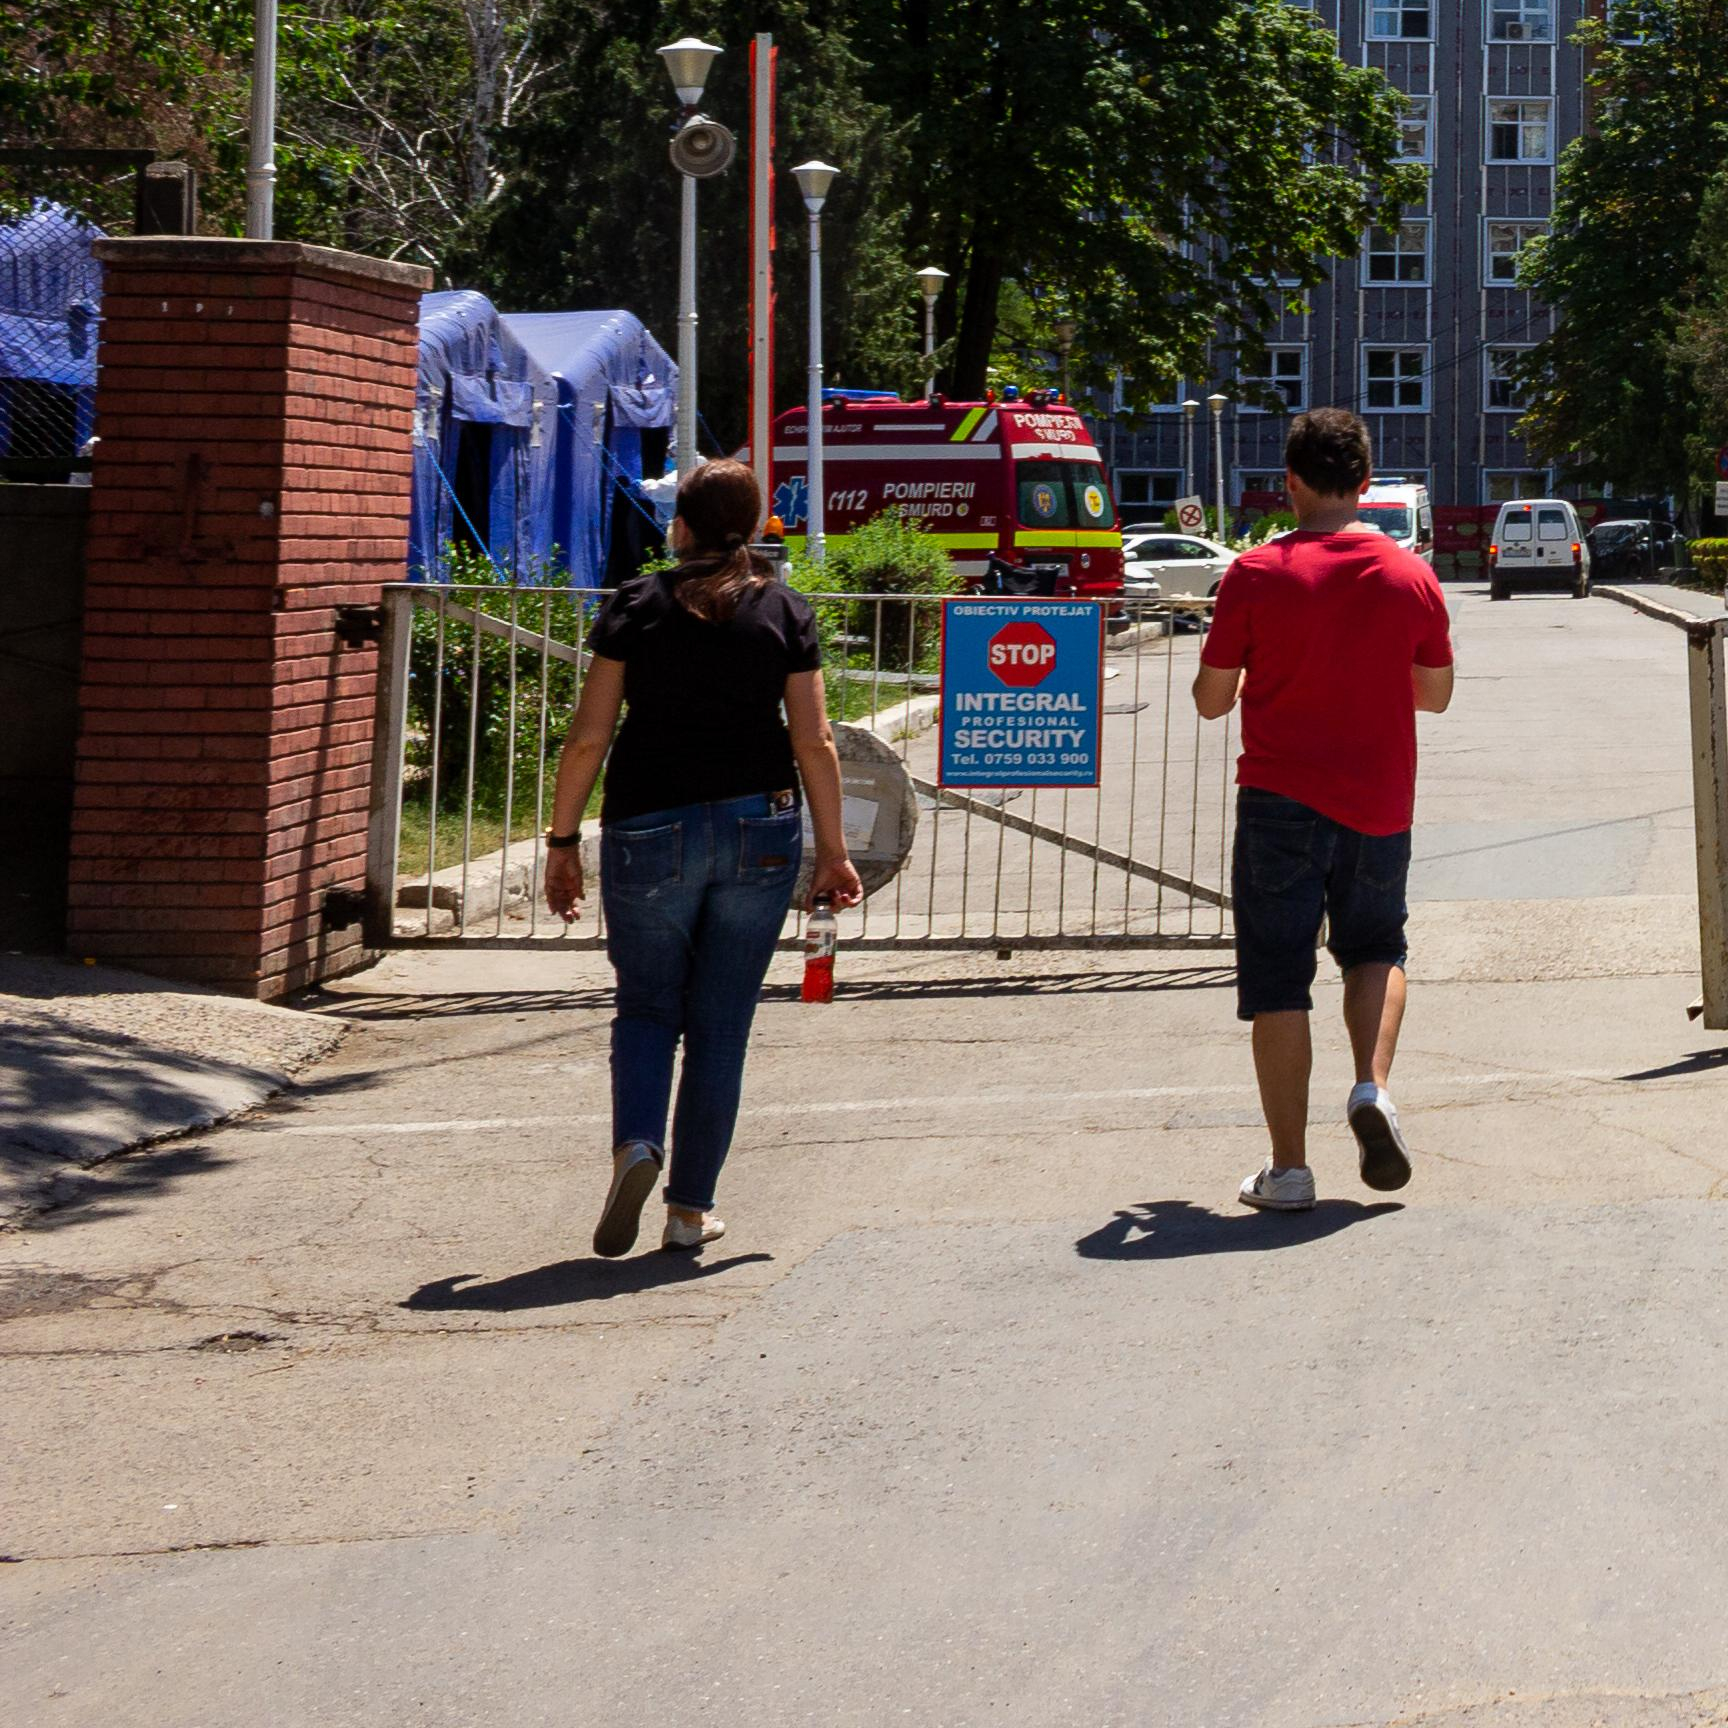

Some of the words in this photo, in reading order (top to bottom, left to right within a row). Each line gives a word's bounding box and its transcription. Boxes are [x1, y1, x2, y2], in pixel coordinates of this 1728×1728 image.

[882, 482, 976, 499] POMPIERII
[837, 489, 868, 511] 112
[899, 502, 953, 518] SMURD
[953, 606, 1018, 617] OBIECTIV
[1022, 605, 1093, 616] PROTEJAT
[990, 643, 1056, 666] STOP
[955, 692, 1087, 712] INTEGRAL
[961, 716, 1079, 727] PROFESIONAL
[954, 729, 1086, 749] SECURITY
[951, 753, 979, 765] Tel.
[983, 753, 1022, 765] 0759
[1027, 753, 1056, 765] 033
[1060, 753, 1089, 765] 900
